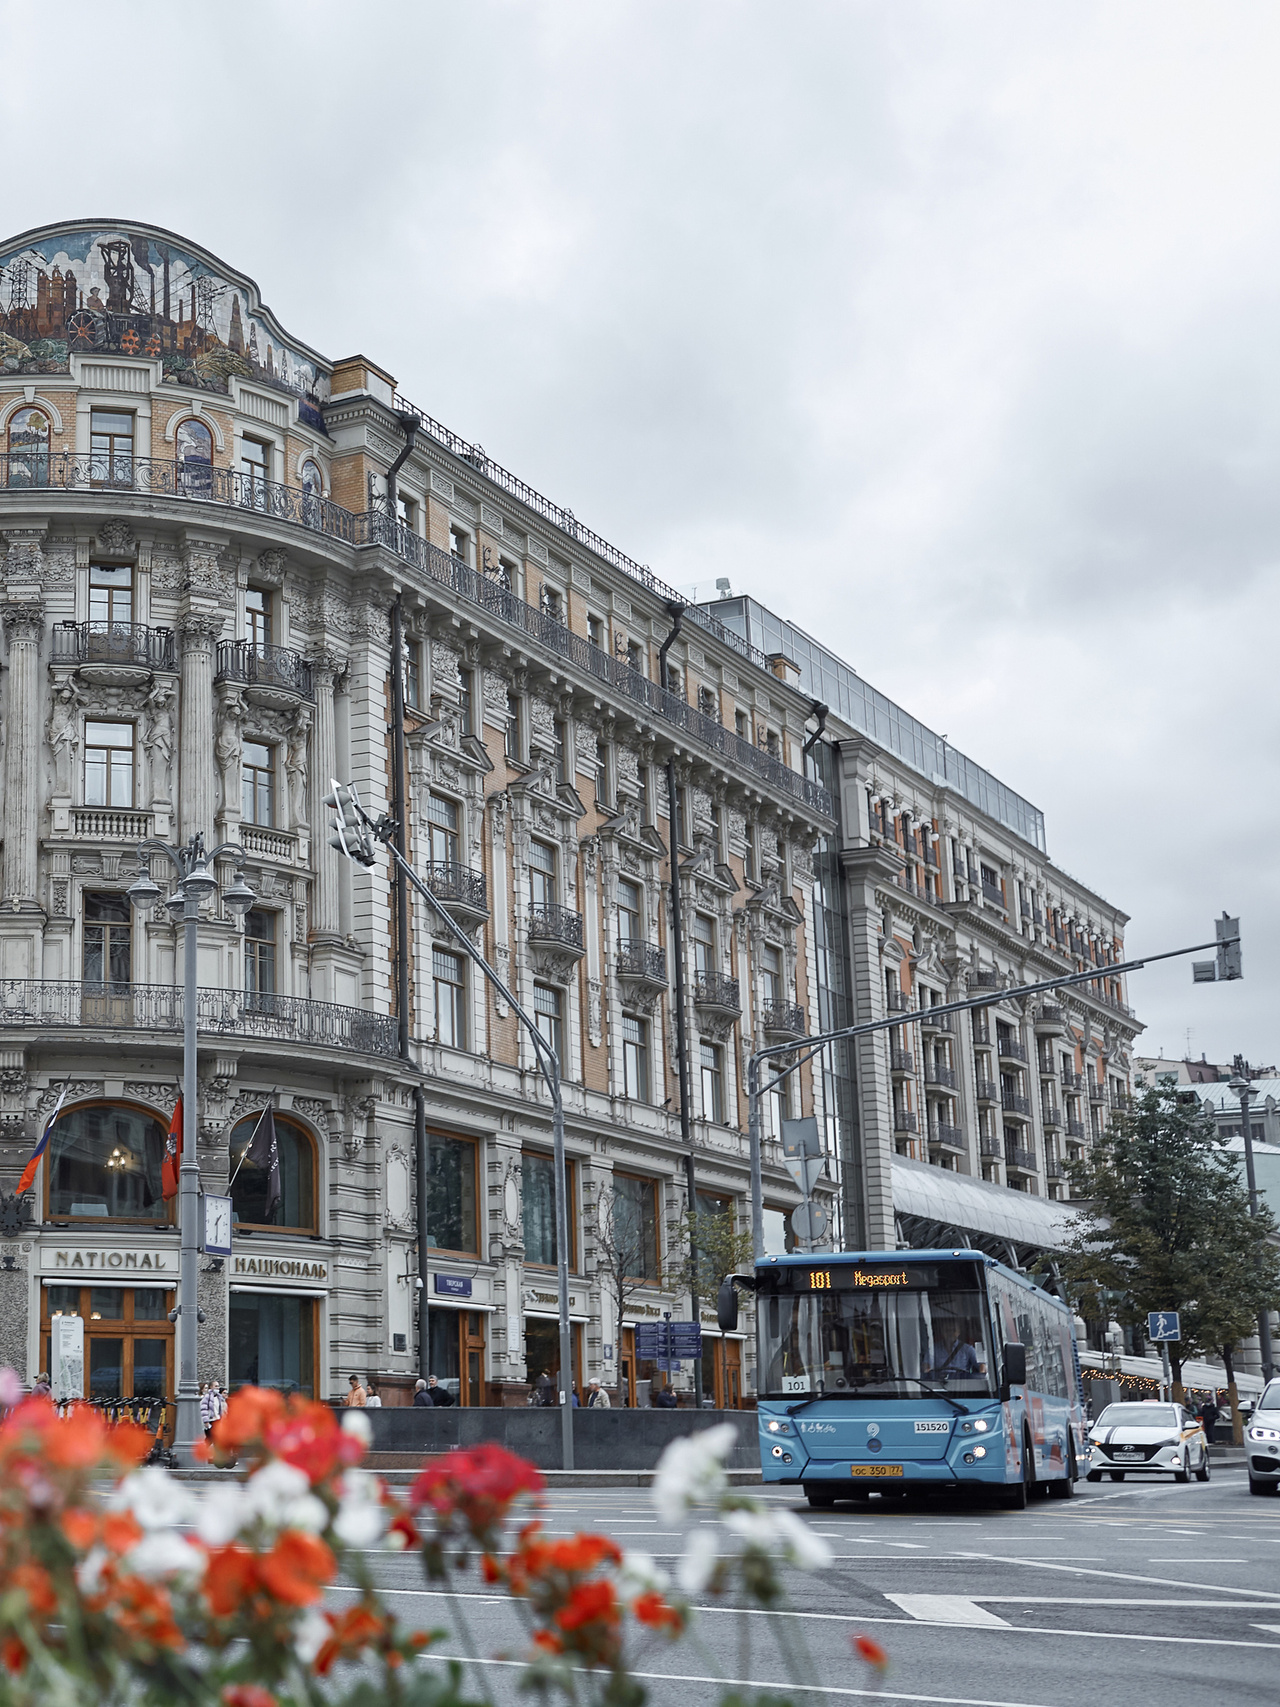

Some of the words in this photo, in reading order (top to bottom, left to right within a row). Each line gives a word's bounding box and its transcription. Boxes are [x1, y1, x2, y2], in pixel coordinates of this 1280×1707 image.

[56, 1251, 166, 1269] NATIONAL
[235, 1257, 327, 1279] НАЦИОНАЛЬ
[809, 1271, 832, 1289] 101
[854, 1270, 909, 1288] Megasport
[788, 1381, 806, 1391] 101
[916, 1422, 949, 1432] 151520
[870, 1466, 887, 1476] 350
[891, 1465, 901, 1474] 77
